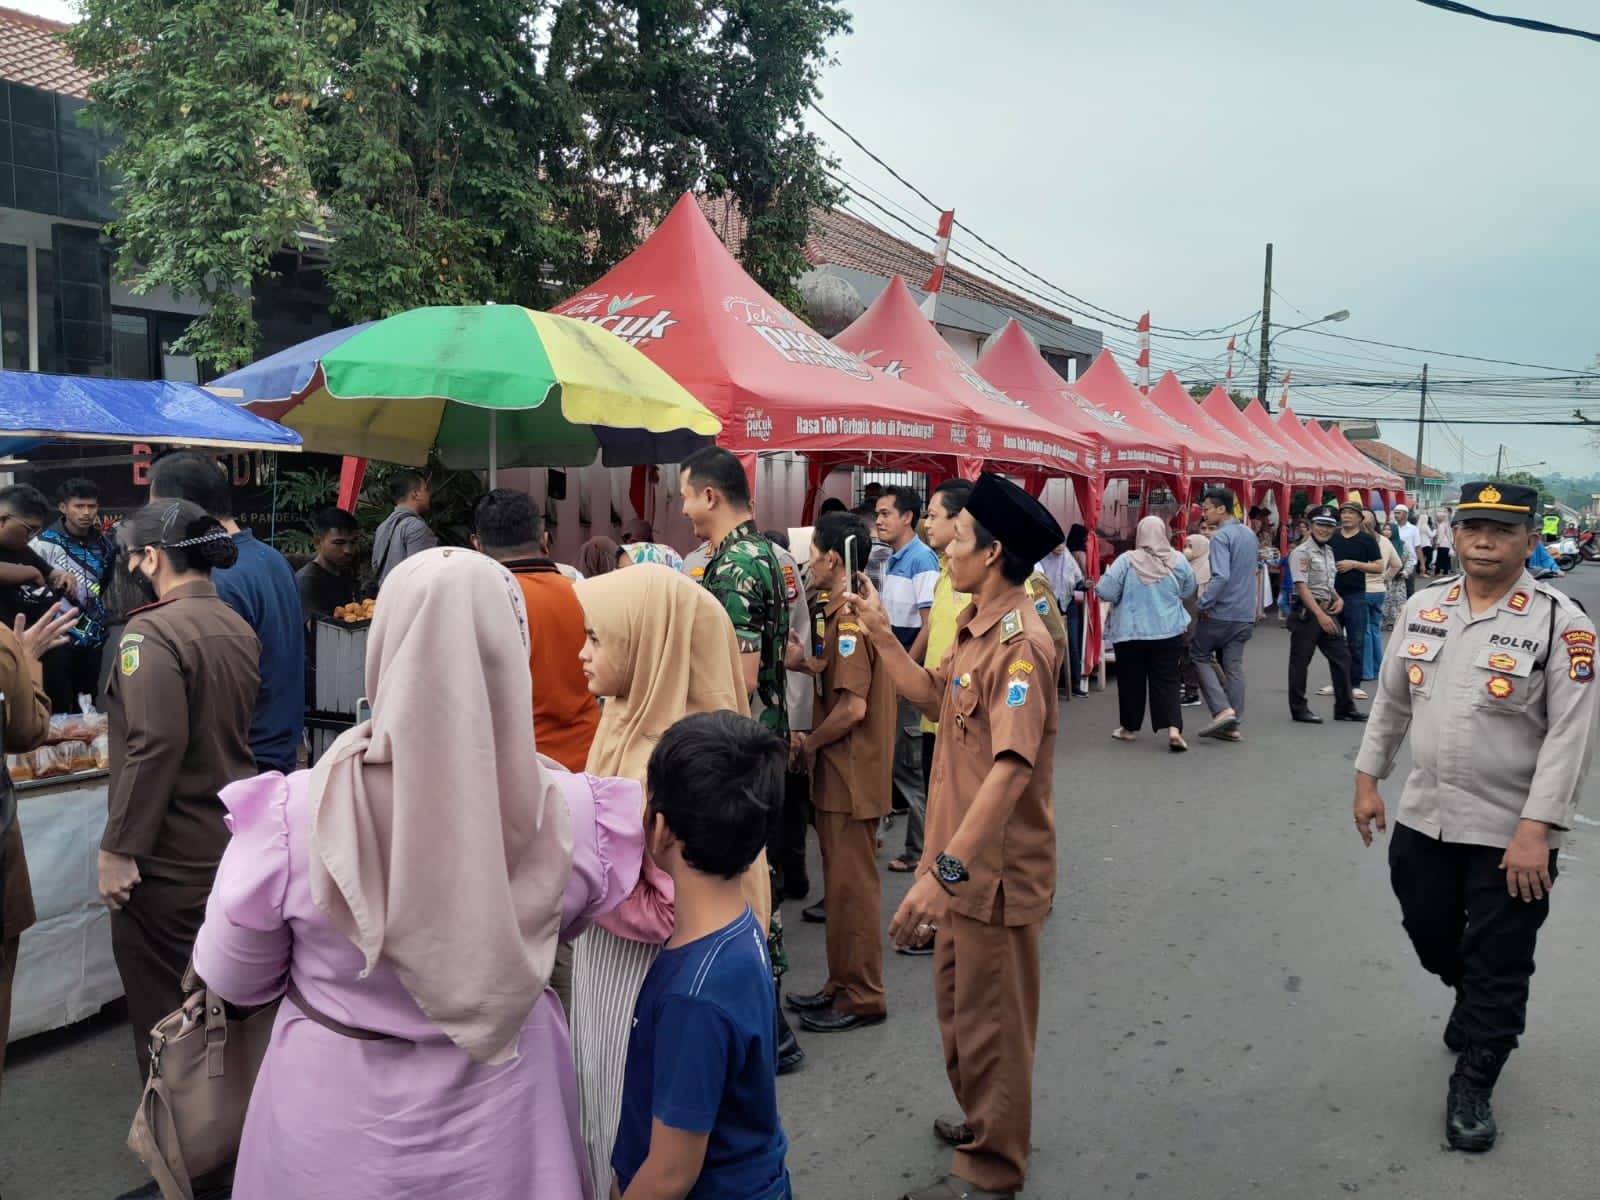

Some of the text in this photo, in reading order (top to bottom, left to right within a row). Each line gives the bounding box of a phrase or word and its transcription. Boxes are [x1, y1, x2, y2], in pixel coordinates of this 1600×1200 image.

[743, 301, 776, 324] Teh
[574, 309, 680, 339] cuk
[796, 415, 820, 434] Rasa
[821, 416, 838, 434] Teh
[1489, 633, 1540, 653] POLRI
